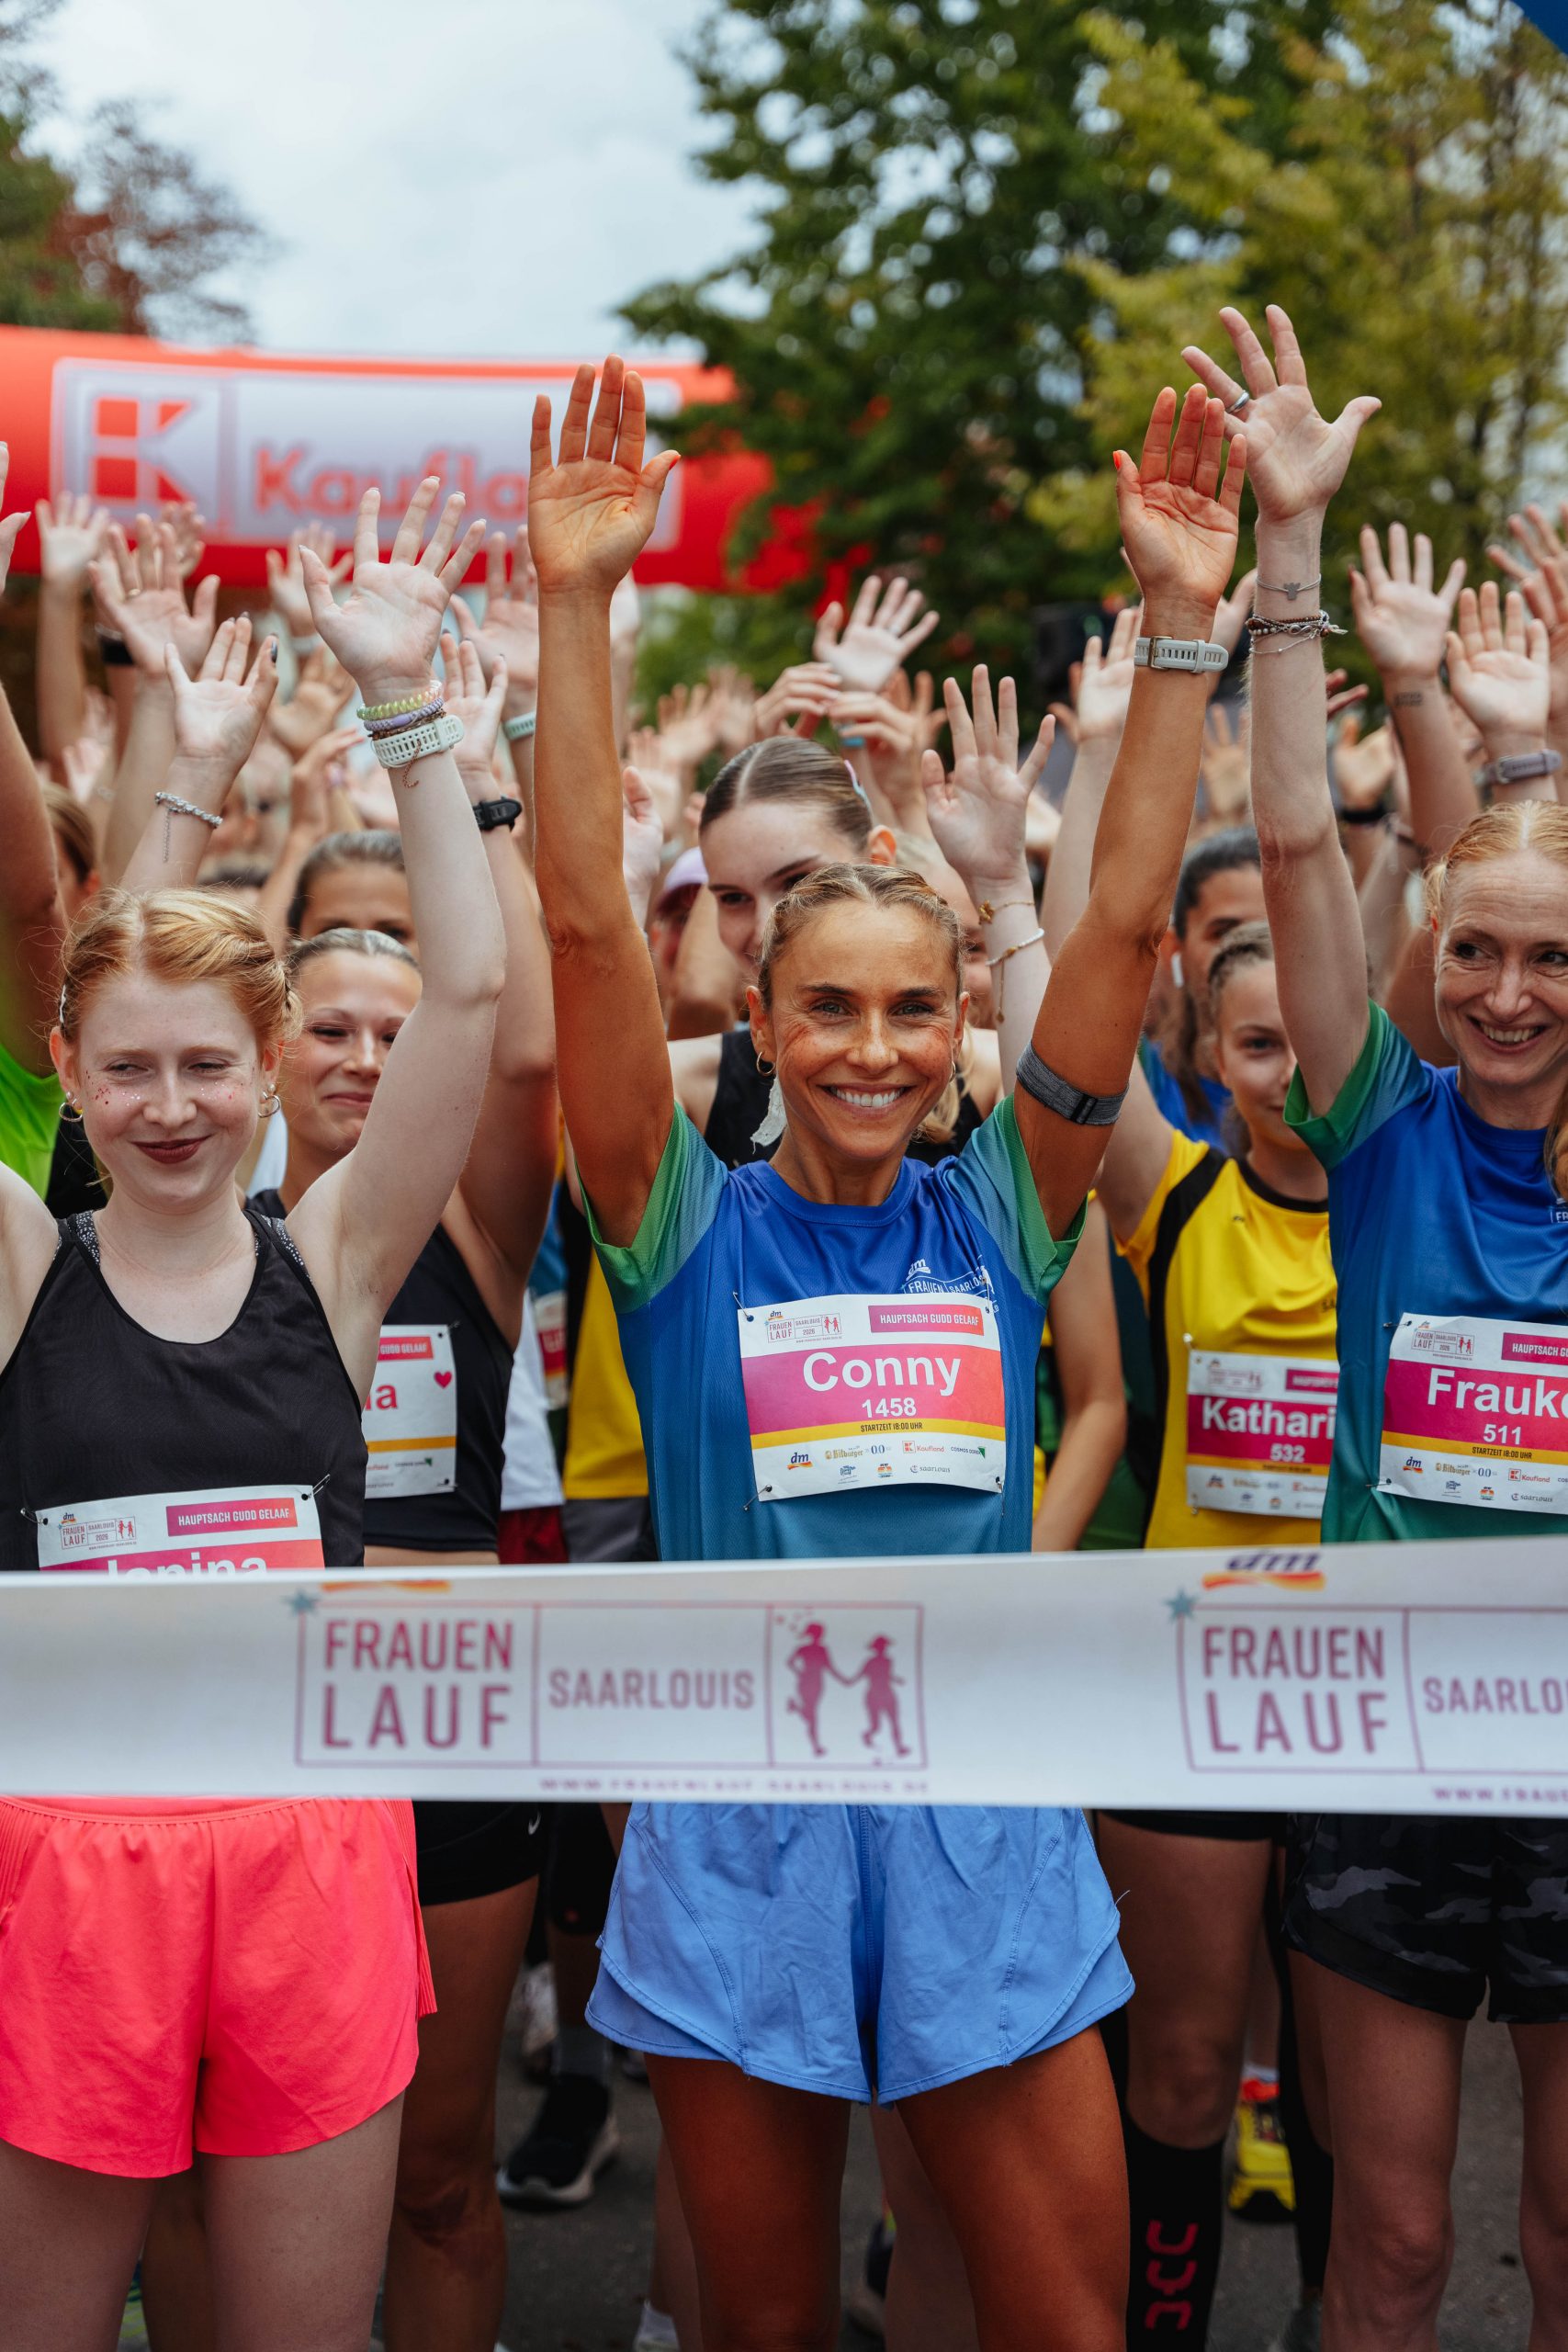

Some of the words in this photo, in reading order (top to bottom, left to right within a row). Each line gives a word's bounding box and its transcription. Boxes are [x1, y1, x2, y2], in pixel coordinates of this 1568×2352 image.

[254, 448, 533, 522] Kaufla
[908, 1280, 944, 1294] FRAUEN
[769, 1321, 792, 1331] FRAUEN
[880, 1313, 928, 1324] HAUPTSACH
[930, 1314, 953, 1324] GUDD
[953, 1314, 979, 1326] GELAAF
[770, 1329, 793, 1340] LAUF
[1414, 1339, 1433, 1349] LAUF
[1512, 1343, 1558, 1356] HAUPTSACH
[803, 1351, 961, 1396] Conny
[862, 1396, 918, 1419] 1458
[1201, 1396, 1337, 1441] Kathari
[860, 1422, 892, 1432] STARTZEIT
[910, 1421, 923, 1430] UHR
[1483, 1423, 1521, 1445] 511
[917, 1444, 945, 1453] Kaufland
[1270, 1442, 1305, 1463] 532
[1472, 1446, 1502, 1457] STARTZEIT
[1519, 1452, 1532, 1460] UHR
[790, 1452, 809, 1464] dm
[1405, 1456, 1422, 1468] dm
[1521, 1475, 1551, 1483] Kaufland
[178, 1513, 231, 1526] HAUPTSACH
[232, 1510, 256, 1522] GUDD
[258, 1508, 289, 1521] GELAAF
[62, 1525, 85, 1535] FRAUEN
[63, 1533, 85, 1546] LAUF
[323, 1618, 513, 1672] FRAUEN
[1203, 1626, 1385, 1679] FRAUEN
[547, 1668, 755, 1710] SAARLOUIS
[1422, 1676, 1568, 1714] SAARLO
[322, 1683, 512, 1749] LAUF
[1205, 1690, 1388, 1754] LAUF
